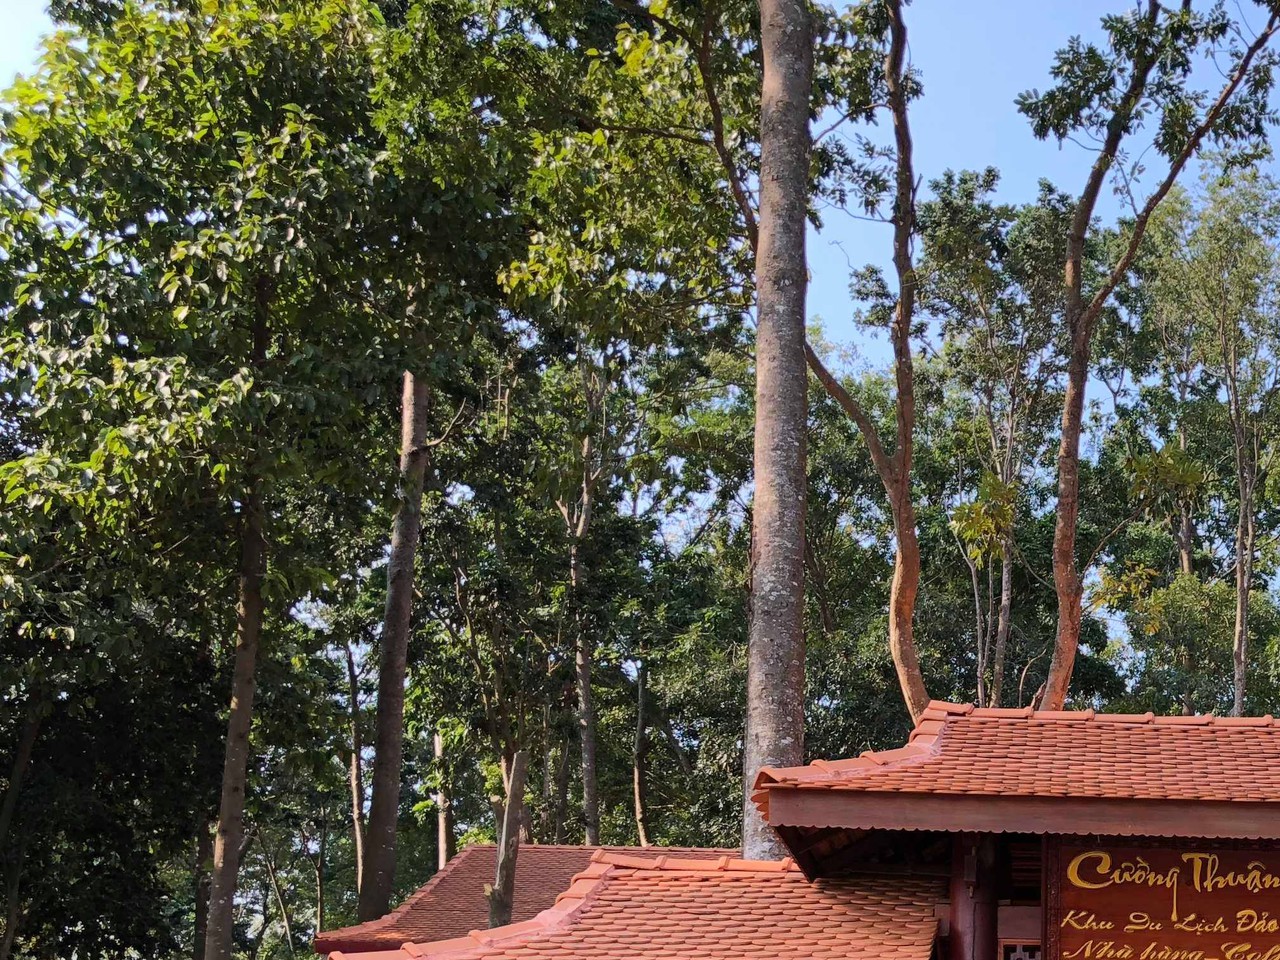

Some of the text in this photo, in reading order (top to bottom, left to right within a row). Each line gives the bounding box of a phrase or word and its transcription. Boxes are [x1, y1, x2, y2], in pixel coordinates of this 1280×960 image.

[1060, 909, 1115, 930] Khu
[1123, 912, 1163, 933] Du
[1173, 913, 1229, 935] Lịch
[1236, 909, 1280, 933] Đảo
[1062, 940, 1136, 960] Nhà
